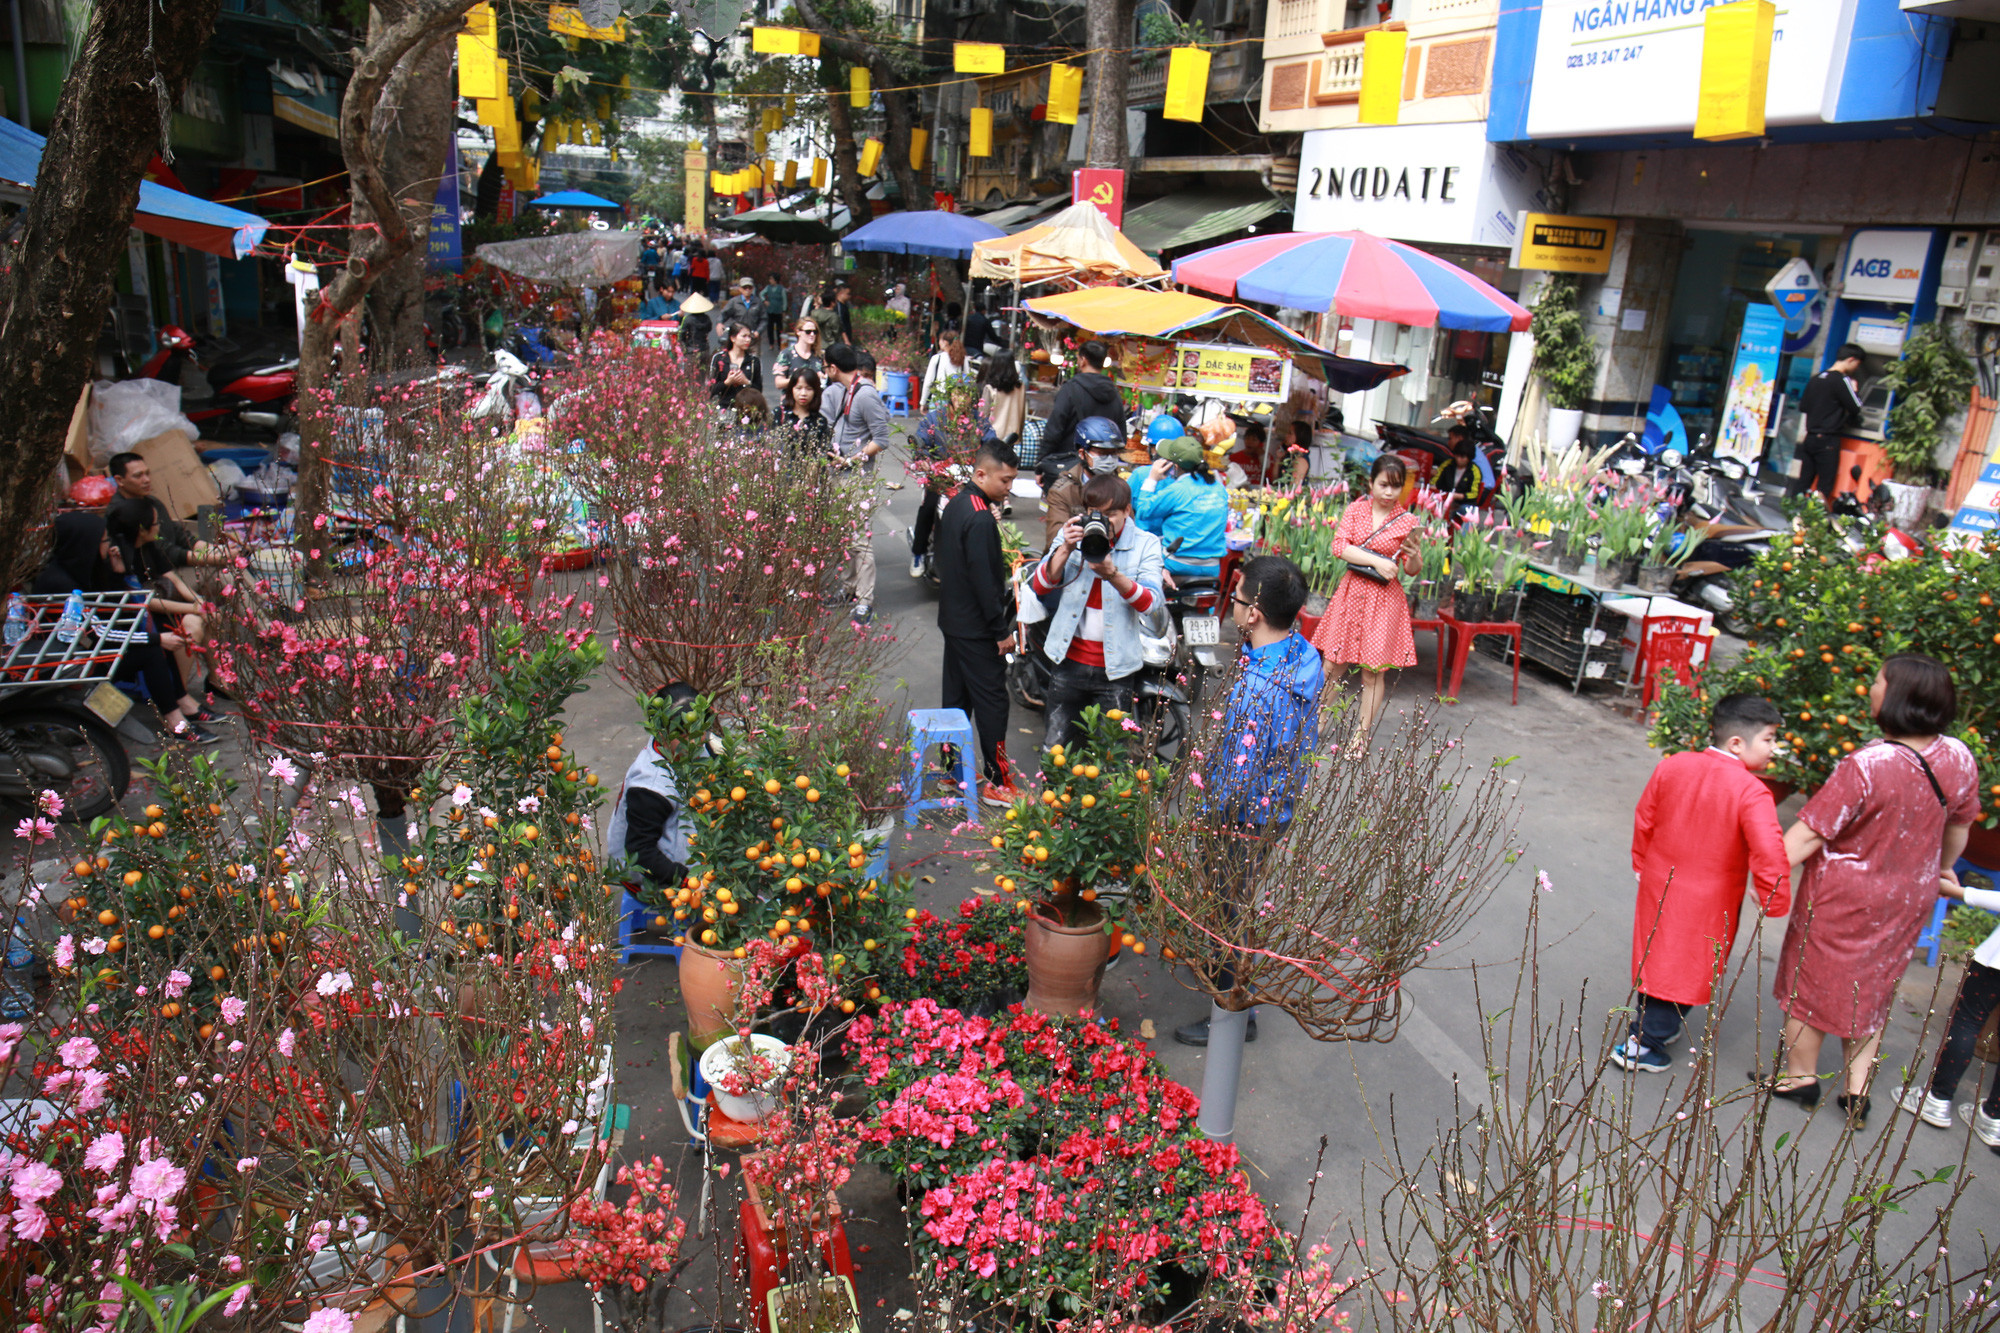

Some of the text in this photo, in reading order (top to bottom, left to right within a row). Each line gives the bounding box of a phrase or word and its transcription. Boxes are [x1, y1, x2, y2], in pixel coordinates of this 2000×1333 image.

[1601, 48, 1620, 65] 247
[1623, 45, 1644, 62] 247
[1850, 258, 1920, 280] ACB ATM
